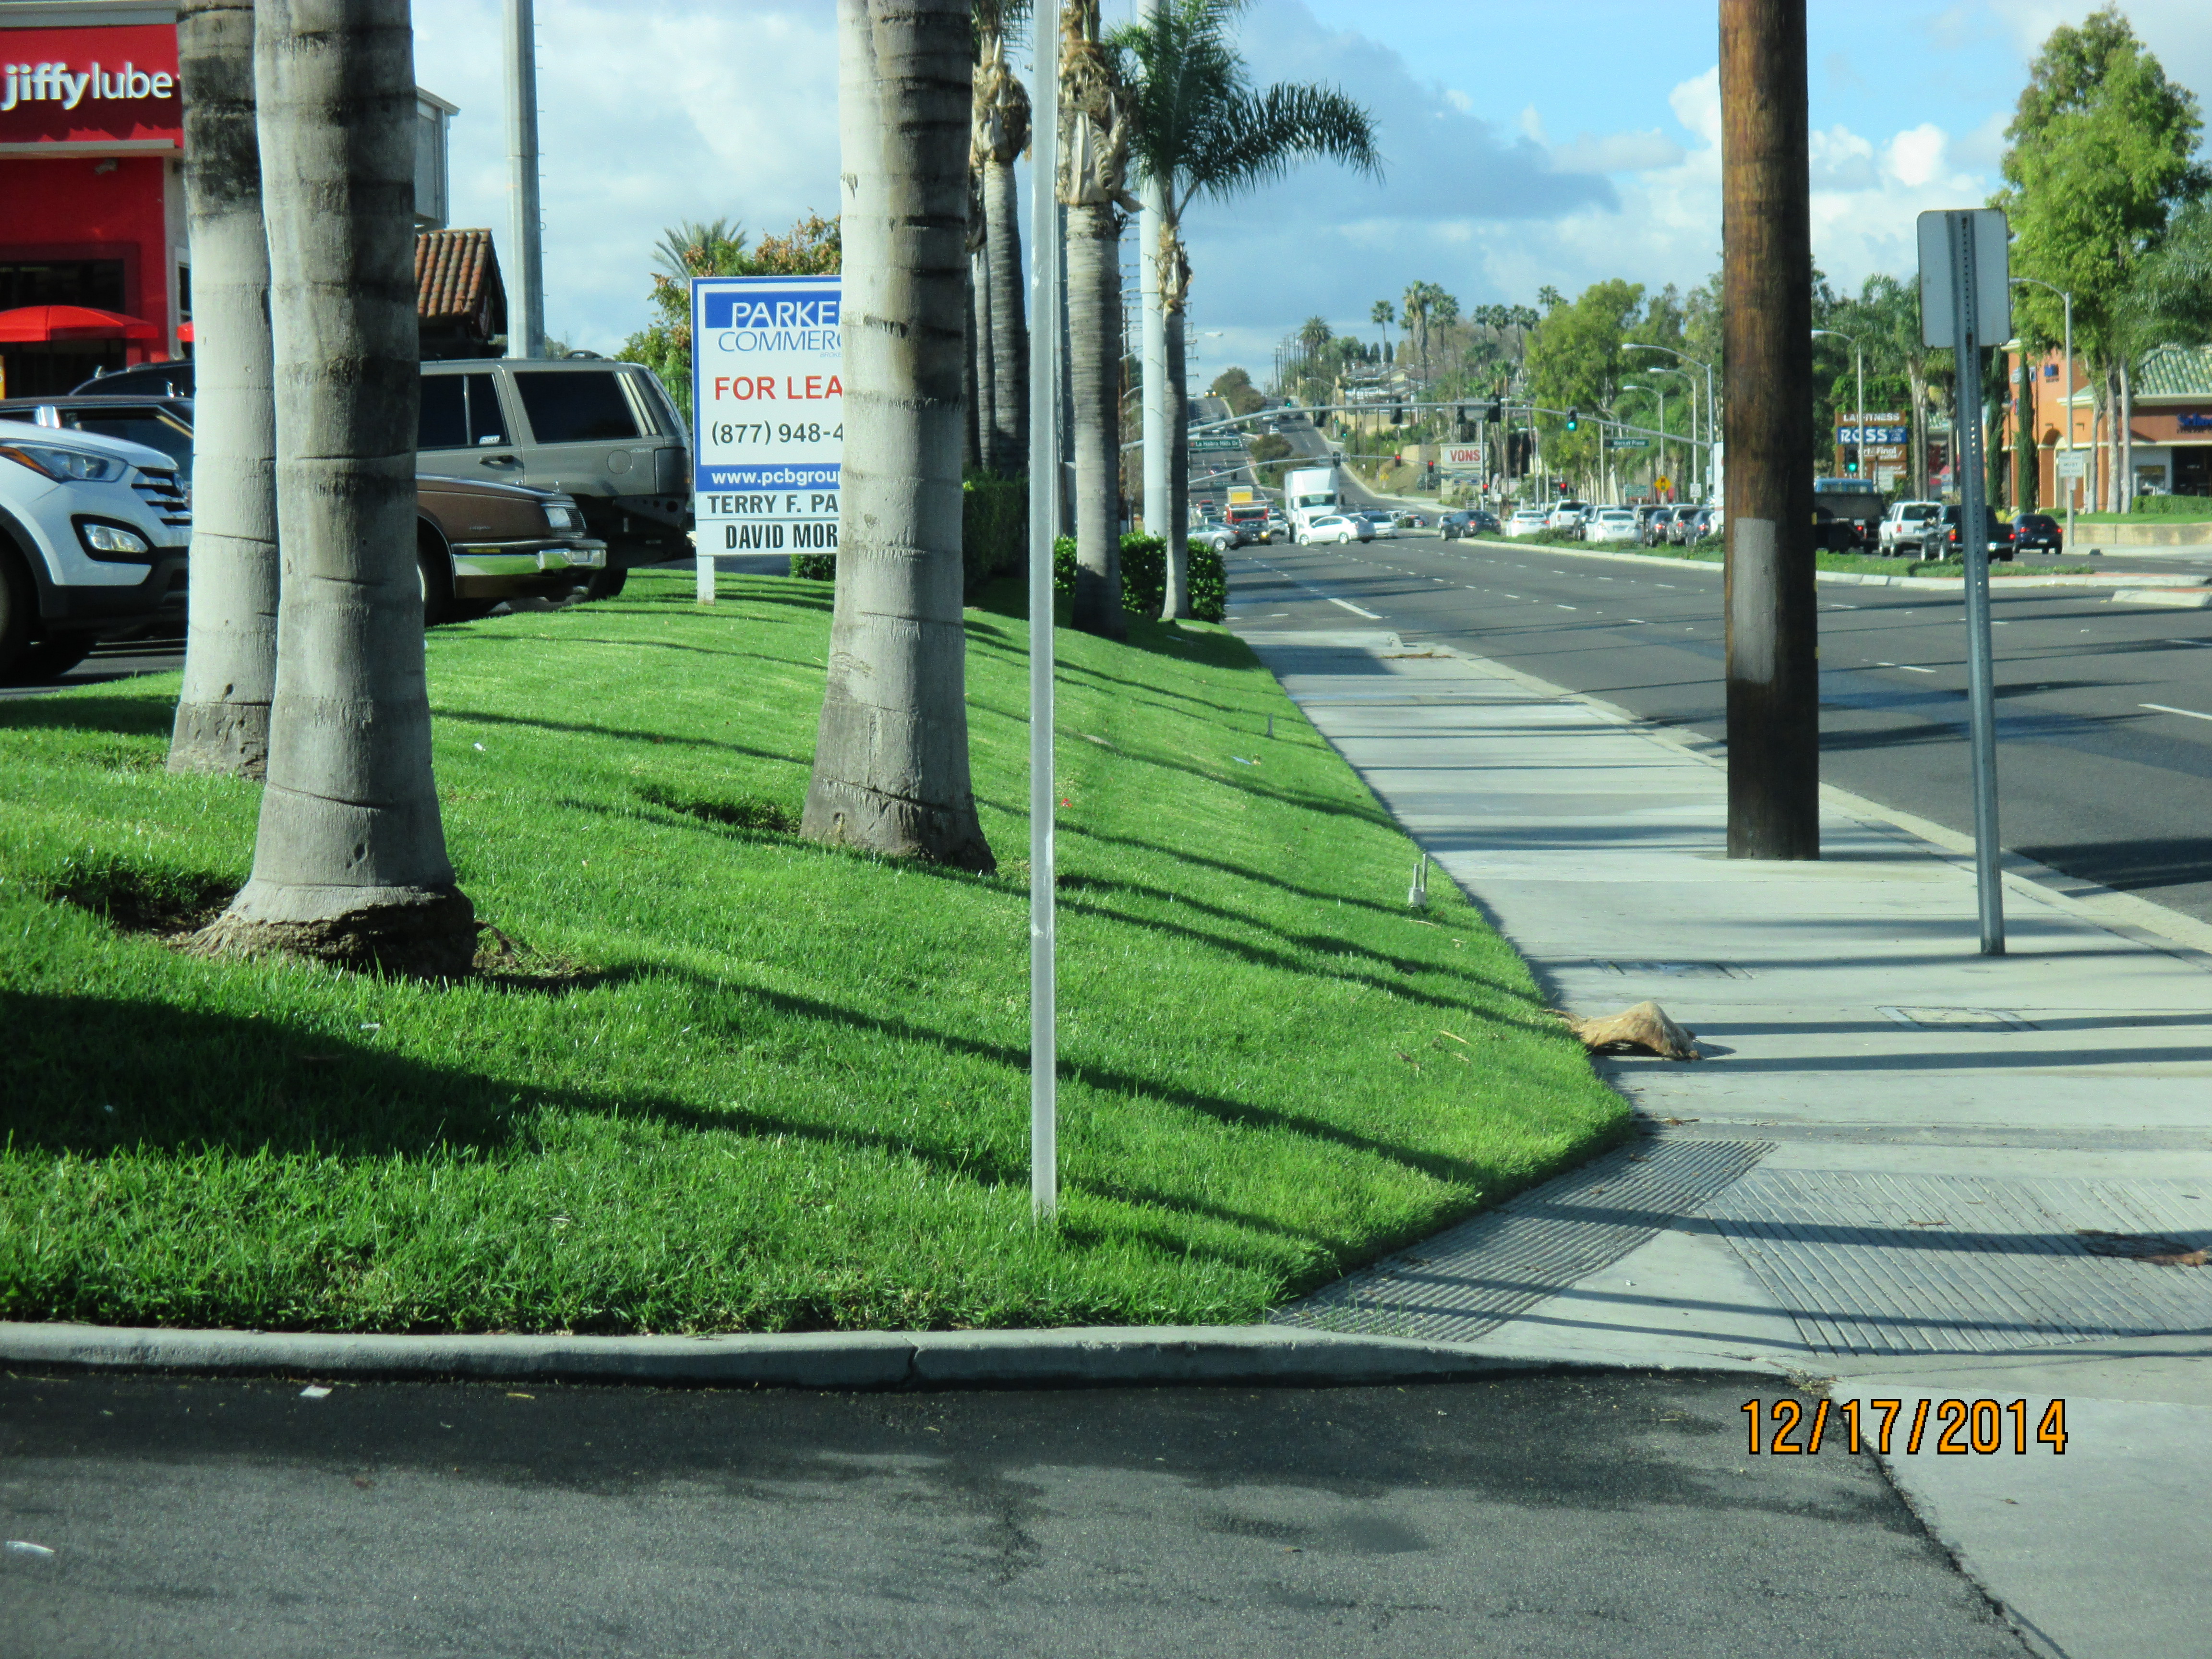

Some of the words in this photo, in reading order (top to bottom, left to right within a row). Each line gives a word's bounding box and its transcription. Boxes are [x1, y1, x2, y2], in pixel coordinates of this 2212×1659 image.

[0, 62, 90, 111] jiffy
[92, 61, 173, 99] lube
[731, 301, 842, 328] PARKE
[718, 330, 842, 352] COMMER
[715, 376, 777, 400] FOR
[787, 375, 842, 399] LEA
[711, 420, 771, 446] (877)
[778, 422, 843, 443] 948-4
[1840, 428, 1888, 443] ROSS
[1450, 449, 1480, 462] VONS
[711, 468, 840, 486] www.pcbgrou
[707, 494, 778, 514] TERRY
[786, 494, 802, 513] F.
[811, 493, 839, 512] PA
[725, 524, 784, 549] DAVID
[793, 523, 838, 548] MOR
